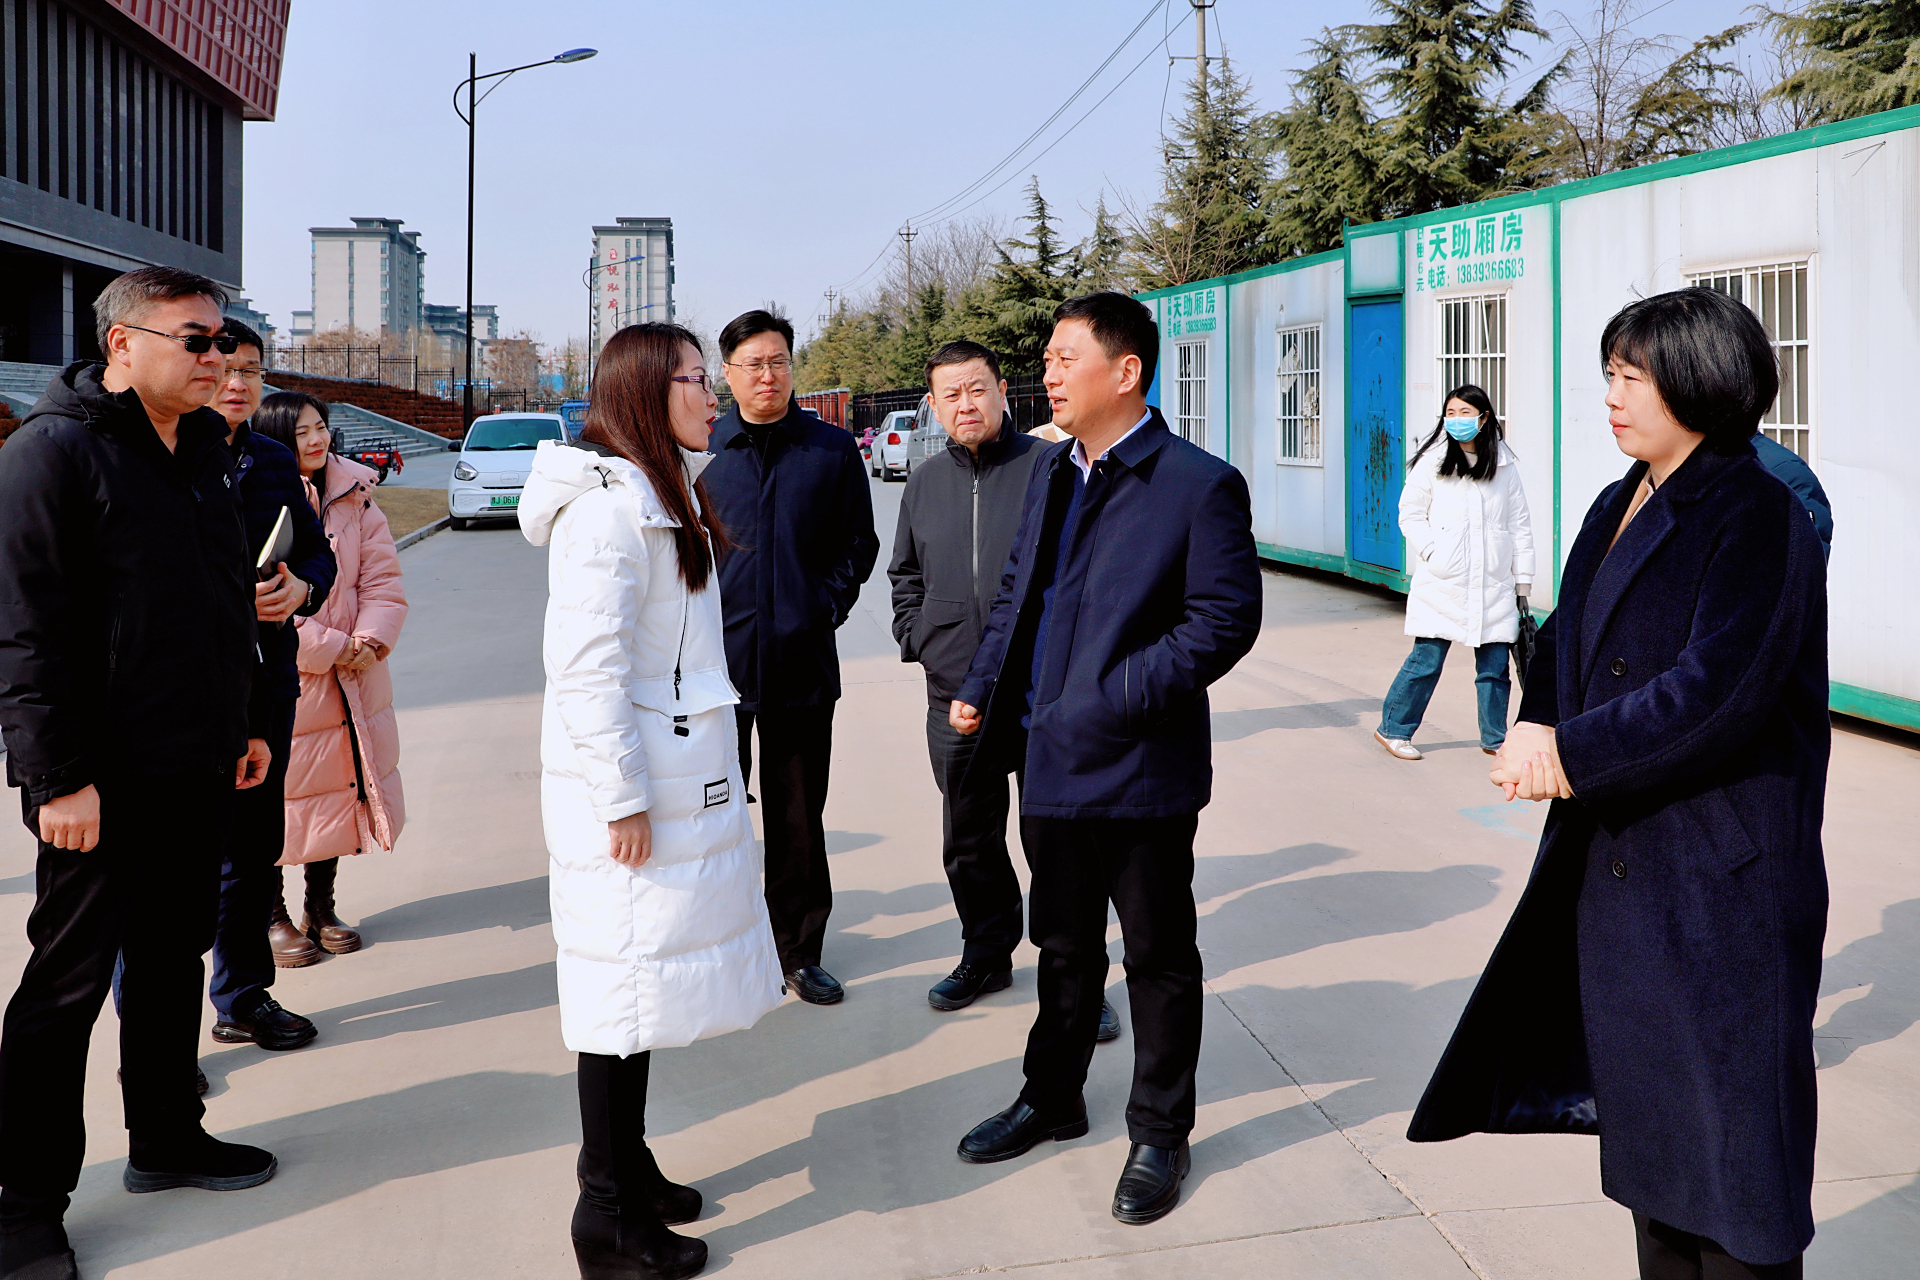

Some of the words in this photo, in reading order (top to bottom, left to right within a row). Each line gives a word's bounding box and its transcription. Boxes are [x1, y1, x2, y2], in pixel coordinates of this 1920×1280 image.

[1428, 212, 1523, 263] 天助厢房
[1457, 257, 1524, 285] 13839366683
[1173, 289, 1216, 319] 天助厢房
